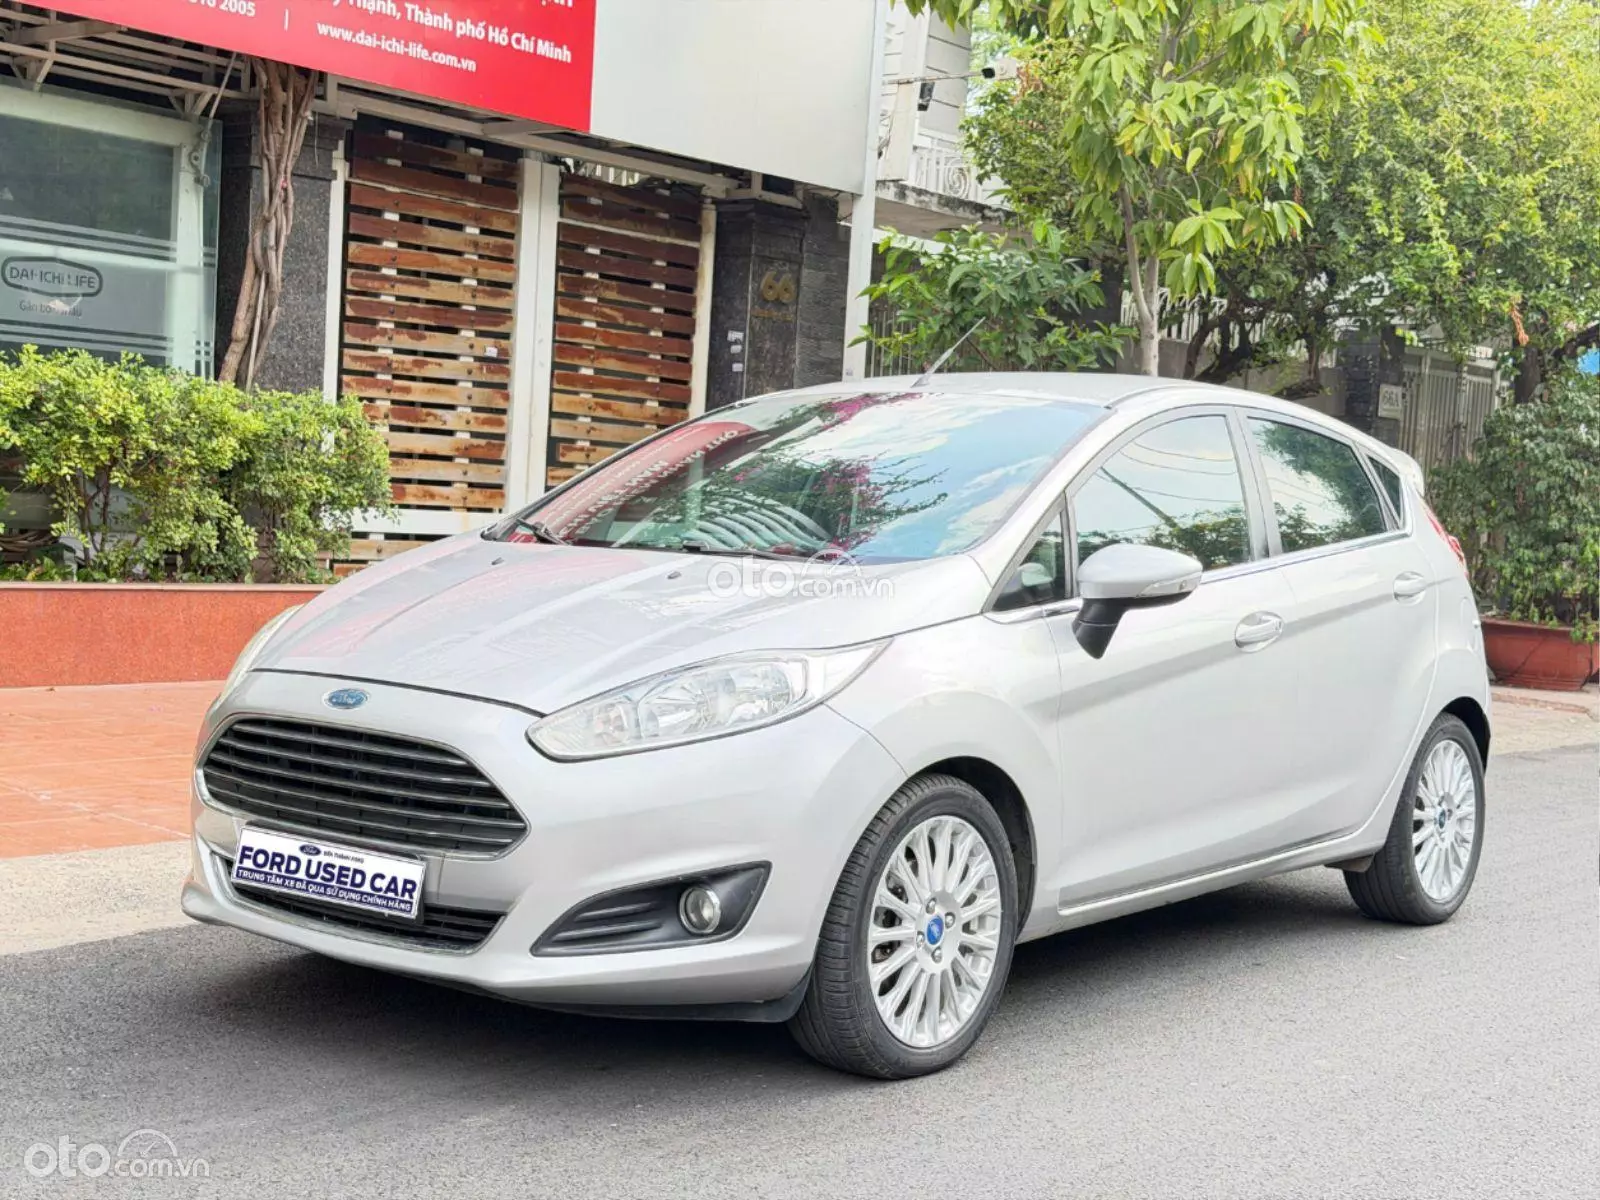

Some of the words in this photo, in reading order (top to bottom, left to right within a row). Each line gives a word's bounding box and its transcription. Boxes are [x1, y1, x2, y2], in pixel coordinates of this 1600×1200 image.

[316, 22, 477, 73] www.dai-ichi-life.com.vn
[404, 2, 453, 31] Thành
[456, 18, 486, 41] phố
[488, 25, 509, 46] Hồ
[511, 32, 536, 54] Chí
[536, 38, 572, 63] Minh
[761, 270, 795, 303] 66
[238, 845, 302, 875] FORD
[305, 858, 367, 889] USED
[369, 872, 417, 899] CAR
[238, 869, 265, 881] TRUNG
[266, 874, 283, 886] TÂM
[307, 884, 325, 894] QUA
[361, 893, 387, 906] CHÍNH
